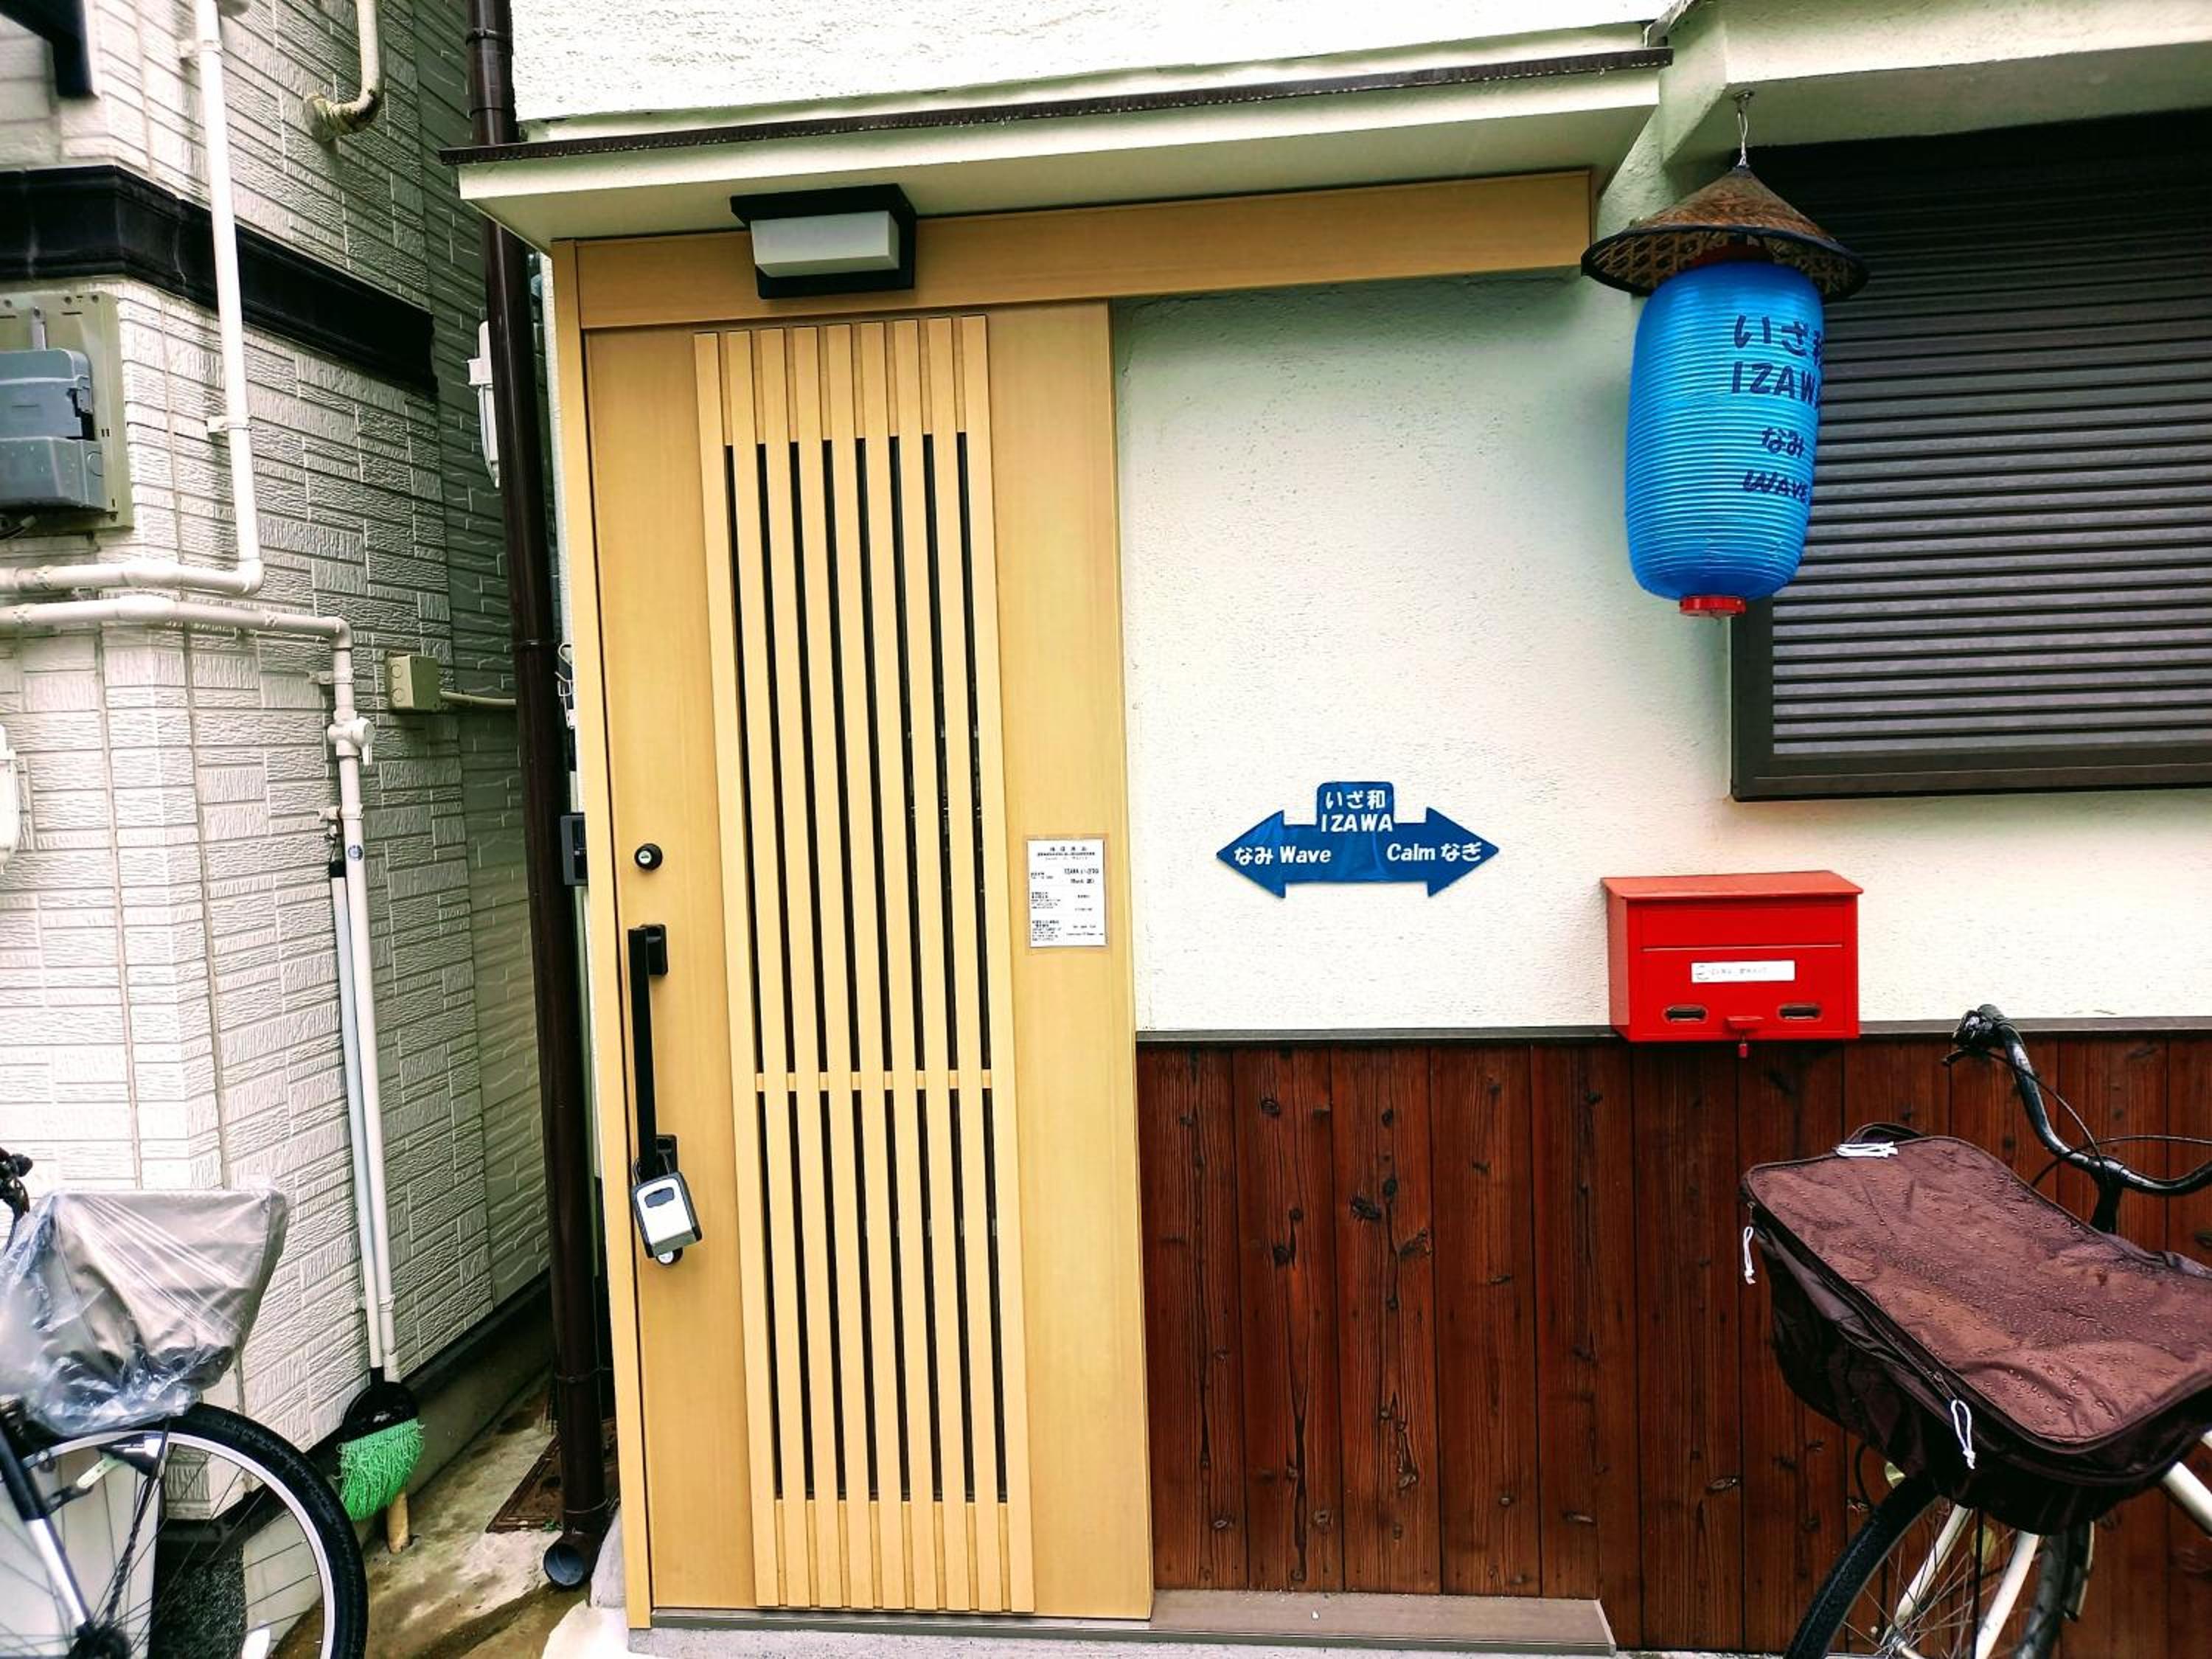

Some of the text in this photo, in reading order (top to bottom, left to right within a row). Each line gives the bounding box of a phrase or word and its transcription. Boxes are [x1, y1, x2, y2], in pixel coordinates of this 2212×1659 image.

[1761, 425, 1806, 459] なみ
[1325, 790, 1385, 810] いざ和
[1321, 813, 1393, 832] IZAWA
[1234, 845, 1332, 865] なみ Wave
[1386, 842, 1483, 862] Calm なぎ
